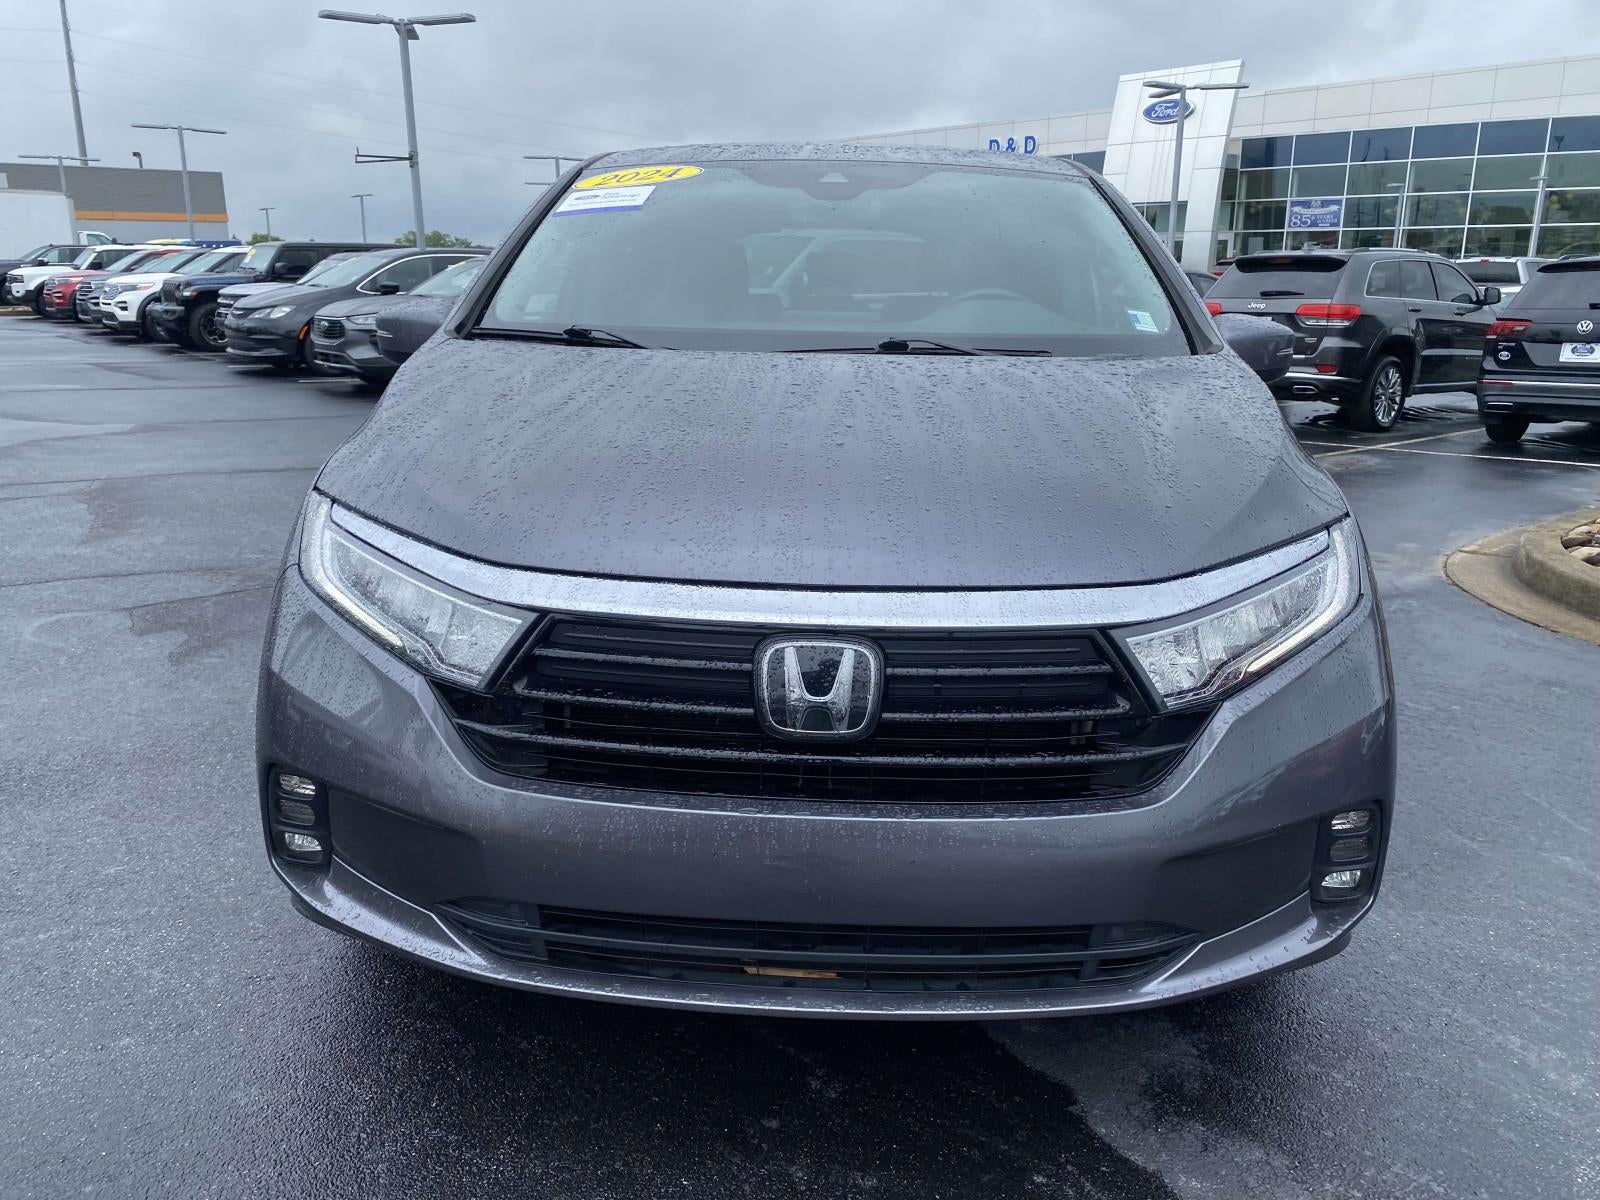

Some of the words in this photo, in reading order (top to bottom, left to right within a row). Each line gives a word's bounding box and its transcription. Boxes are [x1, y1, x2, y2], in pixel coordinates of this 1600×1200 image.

[1151, 102, 1179, 117] Ford
[1006, 137, 1016, 152] &
[1024, 135, 1037, 154] D
[595, 168, 680, 186] 2024
